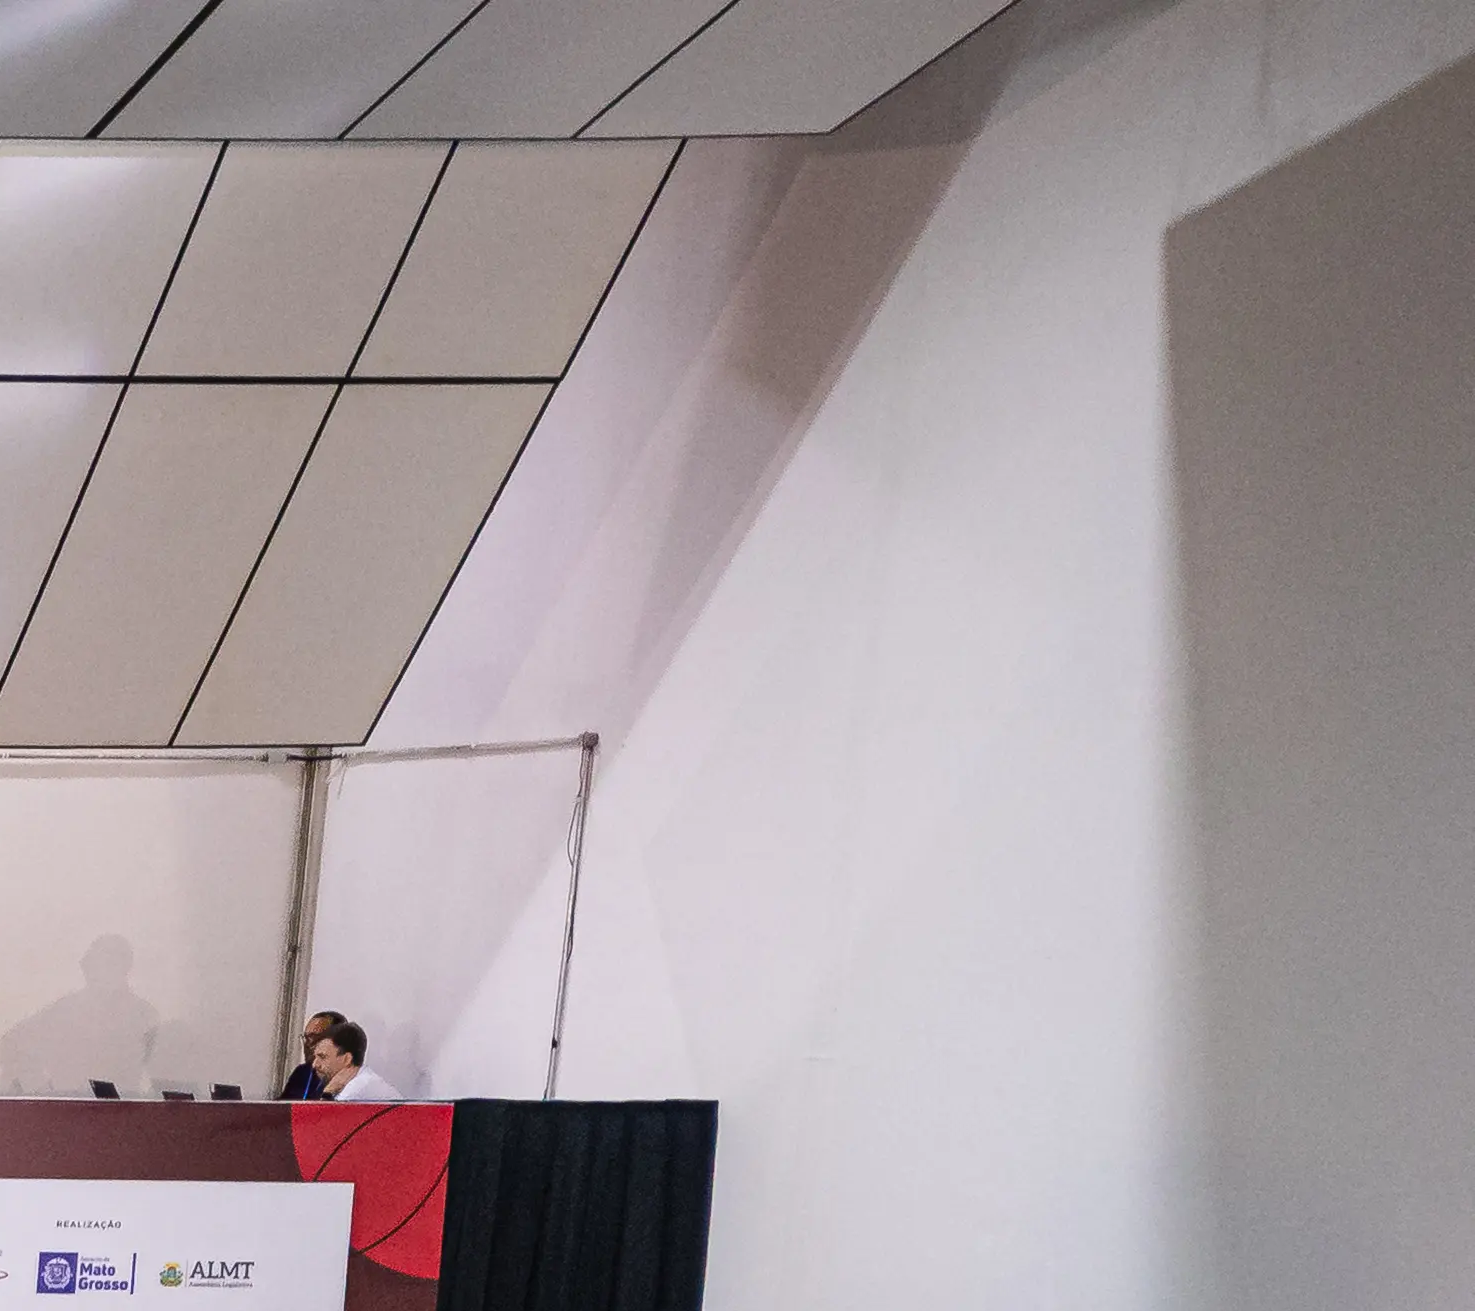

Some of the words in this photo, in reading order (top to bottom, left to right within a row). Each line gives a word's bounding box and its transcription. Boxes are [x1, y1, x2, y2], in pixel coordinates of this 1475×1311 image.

[55, 1219, 122, 1231] REALIZAÇÃO
[79, 1263, 116, 1276] Mato
[189, 1260, 255, 1280] ALMT
[78, 1277, 129, 1291] Grosso
